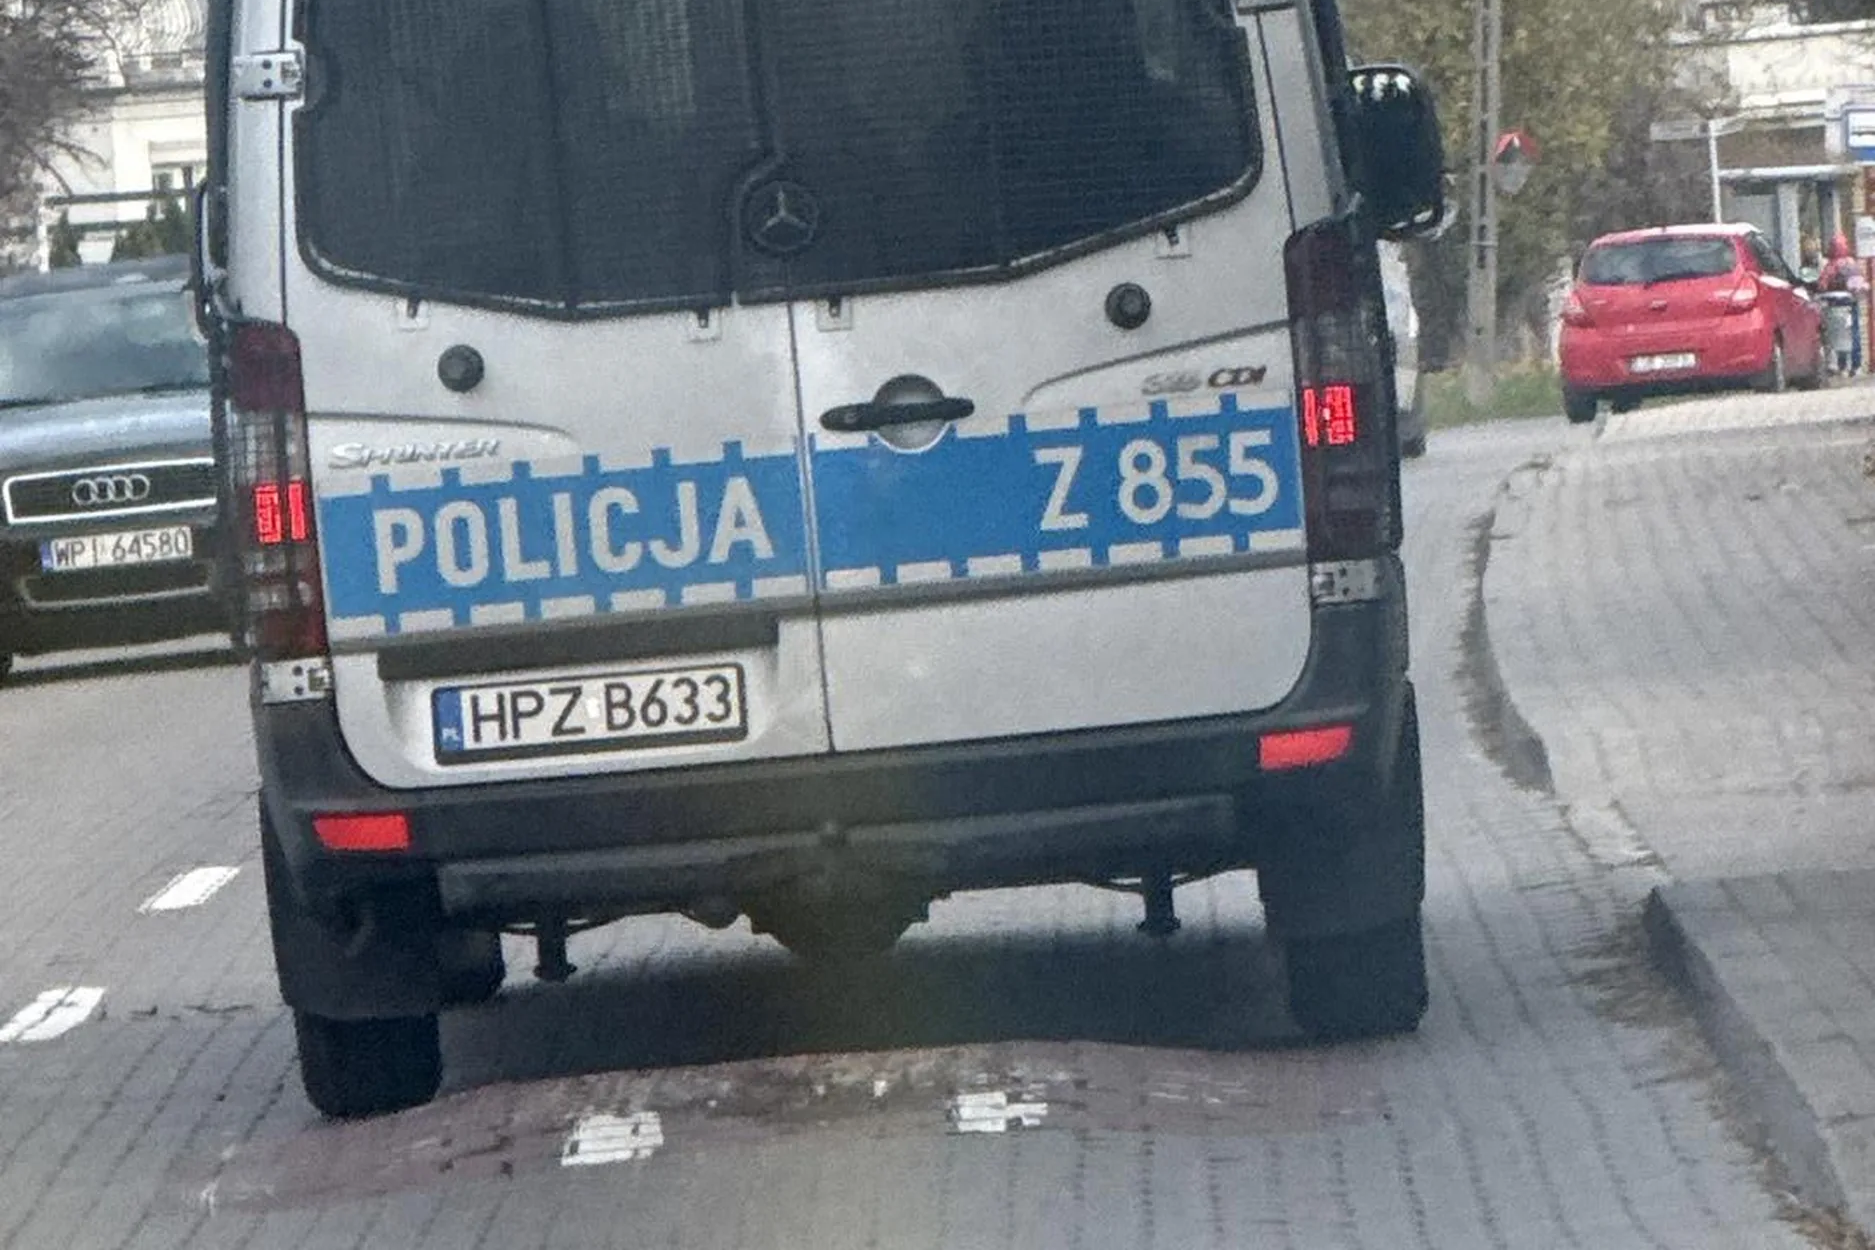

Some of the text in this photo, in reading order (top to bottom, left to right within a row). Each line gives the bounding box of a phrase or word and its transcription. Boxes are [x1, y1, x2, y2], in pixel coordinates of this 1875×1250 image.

[1033, 428, 1280, 531] Z 855
[110, 527, 190, 563] 64580
[373, 475, 775, 595] POLICJA
[469, 684, 587, 744] HPZ
[602, 673, 733, 732] B633
